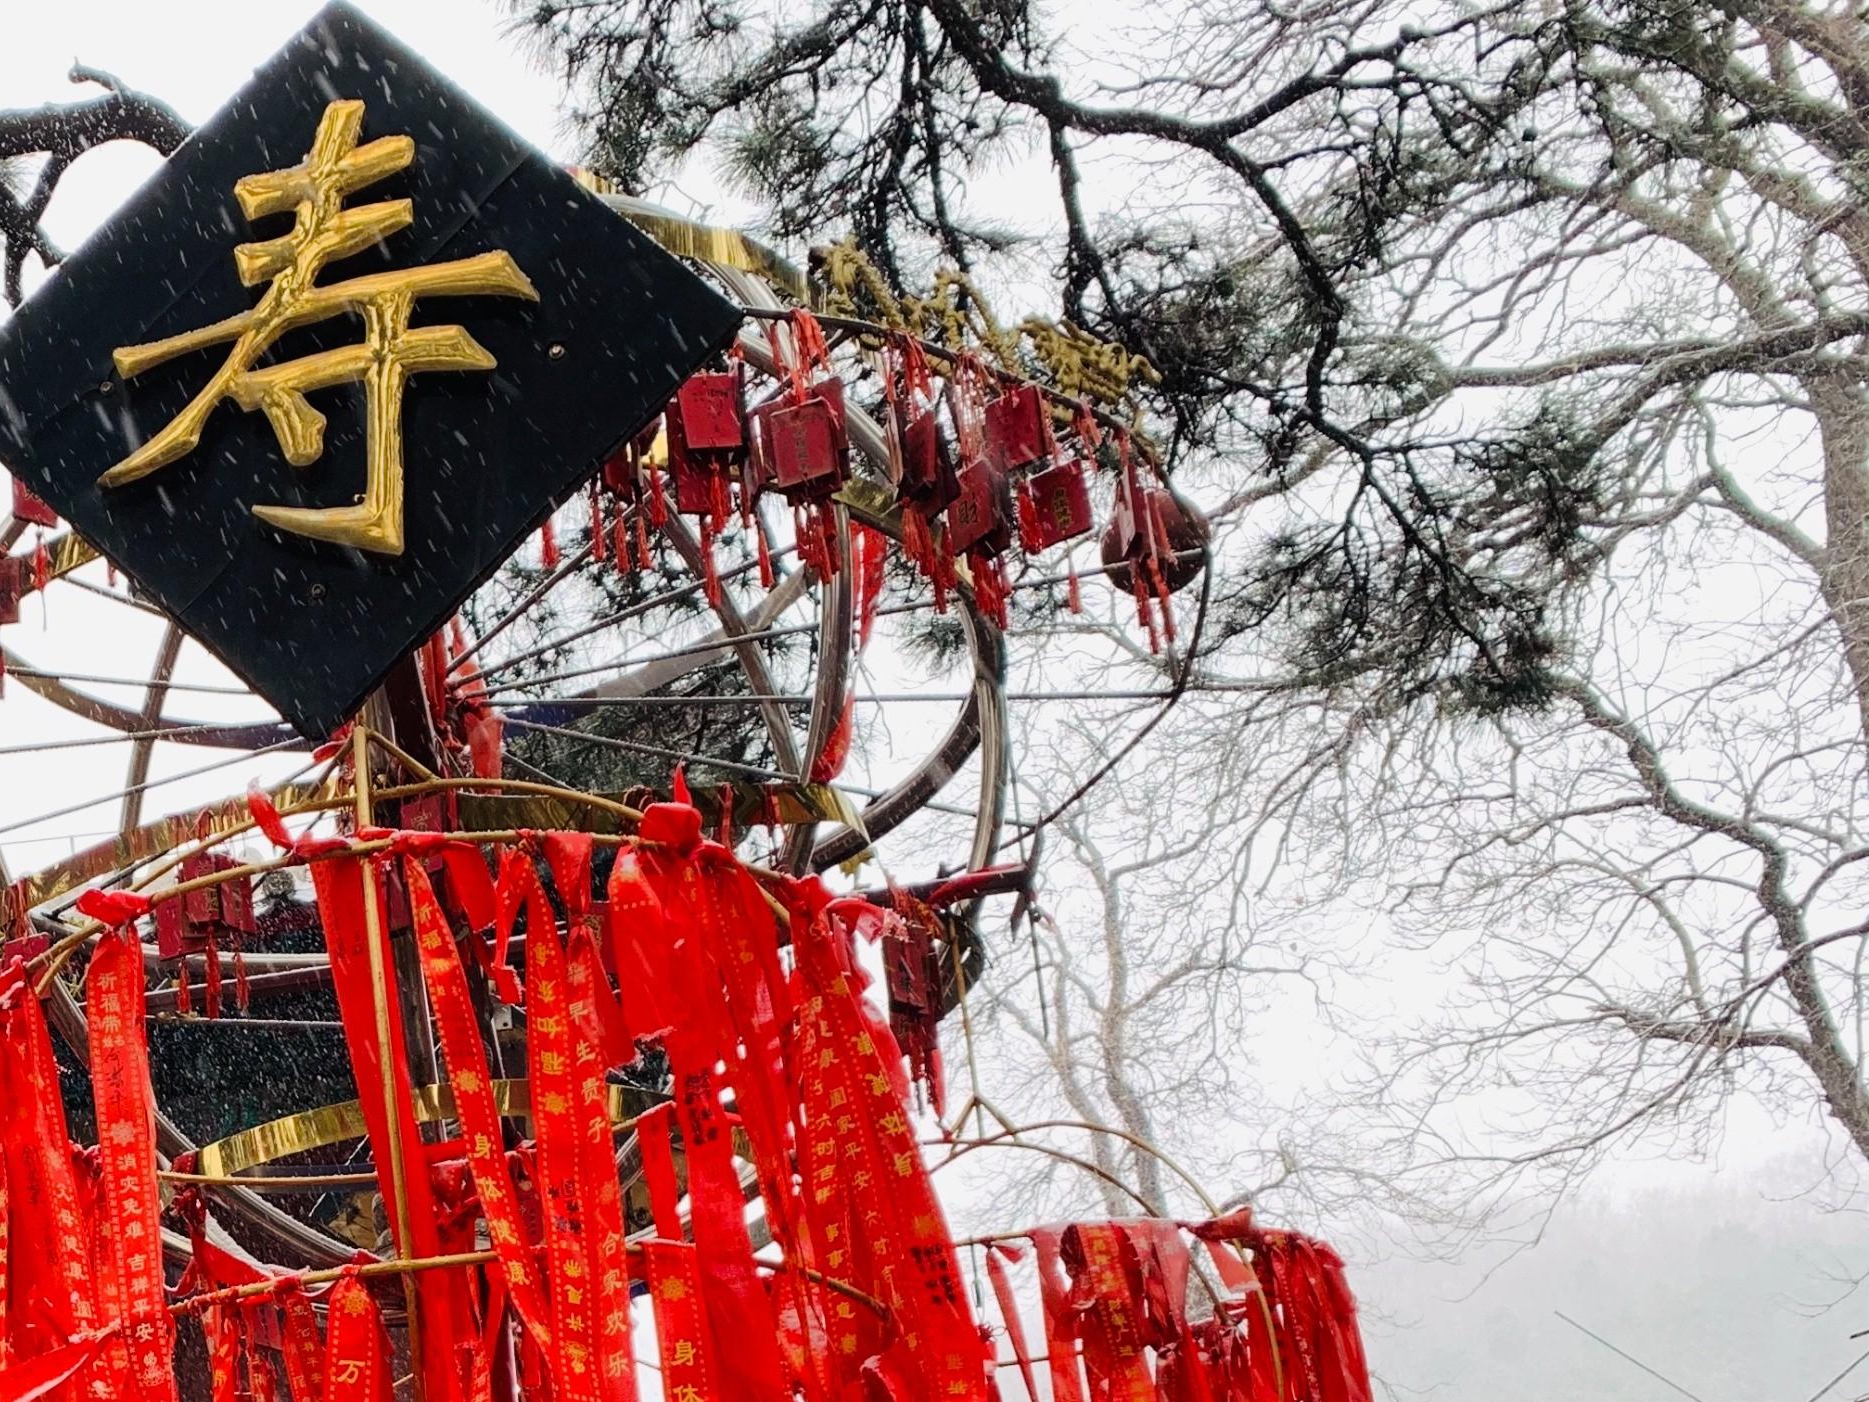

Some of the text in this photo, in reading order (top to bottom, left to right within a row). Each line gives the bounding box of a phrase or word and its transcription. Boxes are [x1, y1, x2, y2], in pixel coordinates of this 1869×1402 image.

[98, 99, 541, 556] 寿
[97, 971, 119, 1032] 祈福带
[568, 1000, 606, 1144] 早生贵子
[116, 1154, 154, 1342] 消灾免难 吉祥平安
[472, 1132, 531, 1285] 身体健康
[602, 1230, 628, 1379] 合家欢乐
